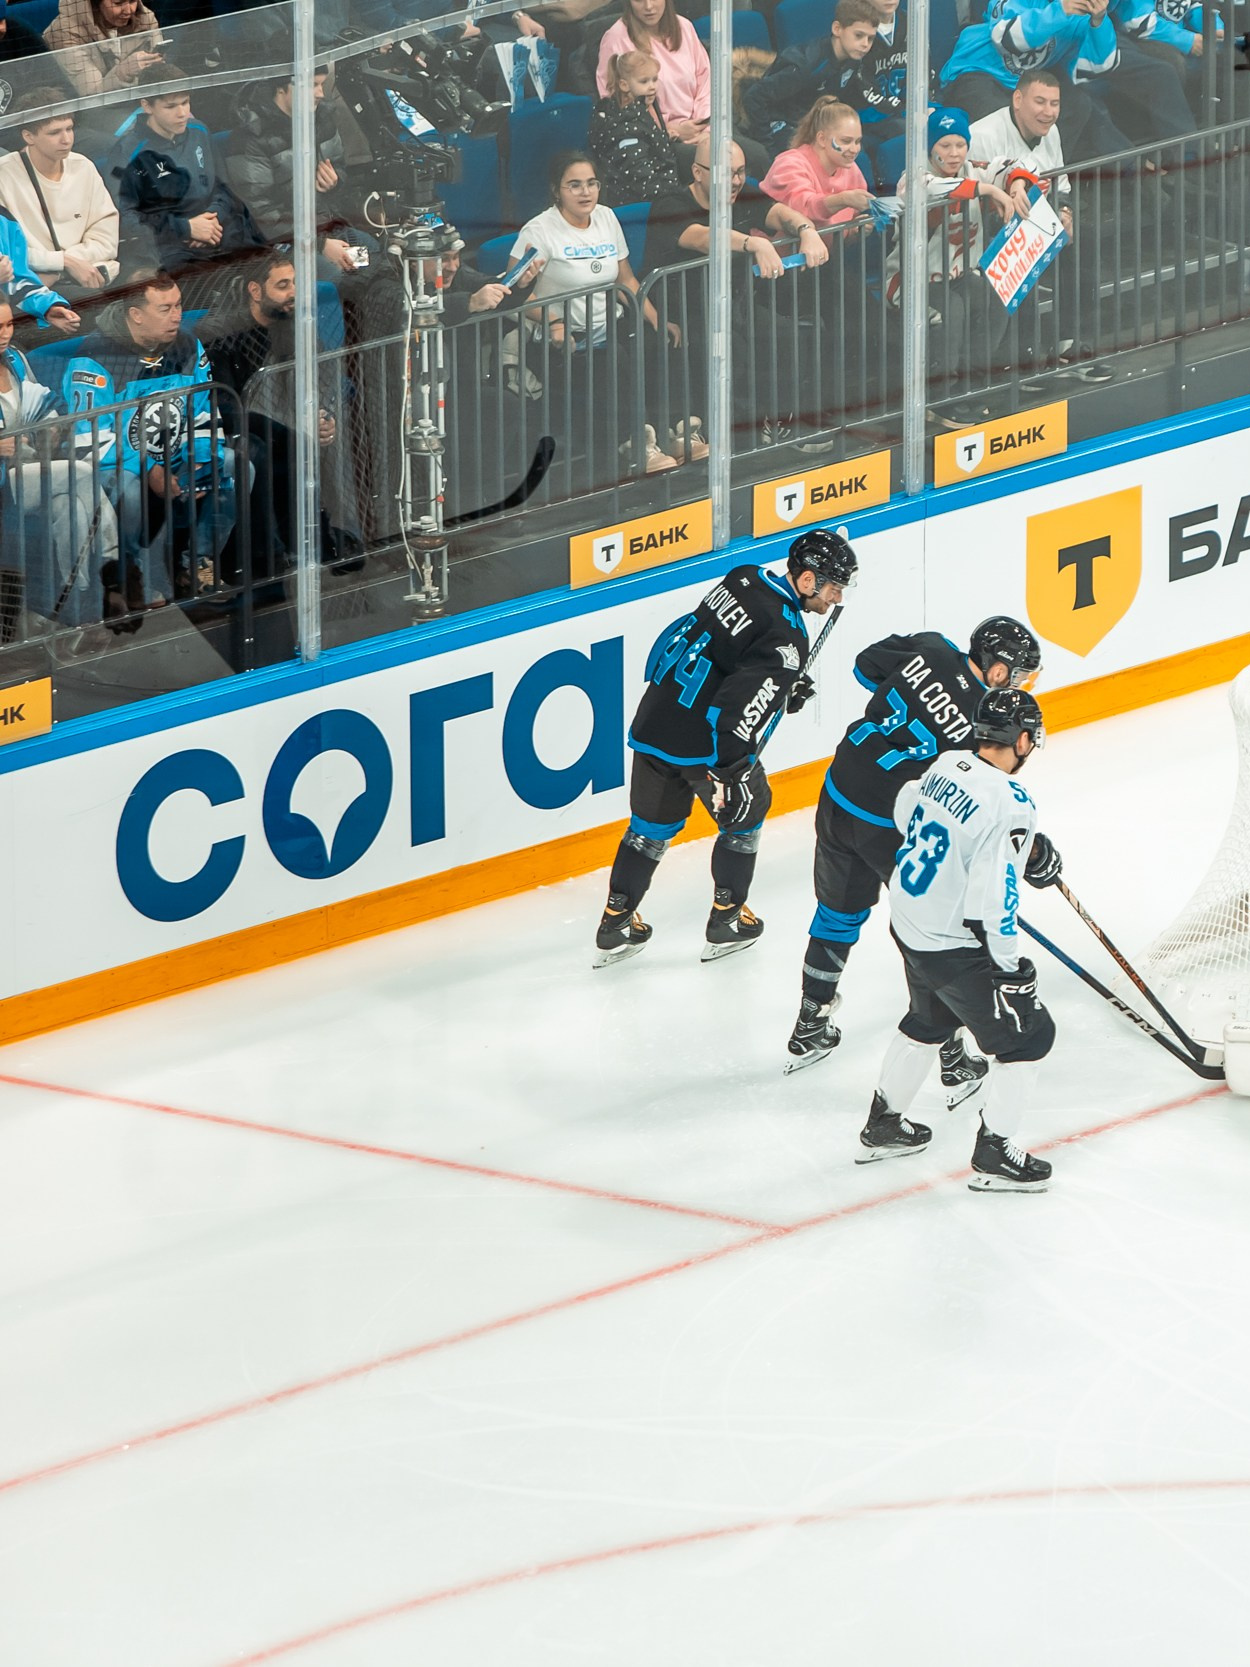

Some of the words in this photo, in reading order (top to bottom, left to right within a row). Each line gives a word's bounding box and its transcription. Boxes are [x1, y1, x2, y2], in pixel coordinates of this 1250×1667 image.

[987, 226, 1027, 288] ХОЧУ
[990, 424, 1046, 455] БАНК
[810, 474, 868, 505] БАНК
[629, 523, 689, 556] БАНК
[1057, 535, 1112, 611] Т
[703, 584, 753, 636] KOVLEV
[653, 614, 713, 709] 44
[848, 687, 938, 772] 77
[901, 655, 932, 690] DA
[918, 681, 973, 744] COSTA
[116, 612, 700, 923] сога
[896, 803, 951, 898] 53
[1108, 996, 1157, 1036] CCM
